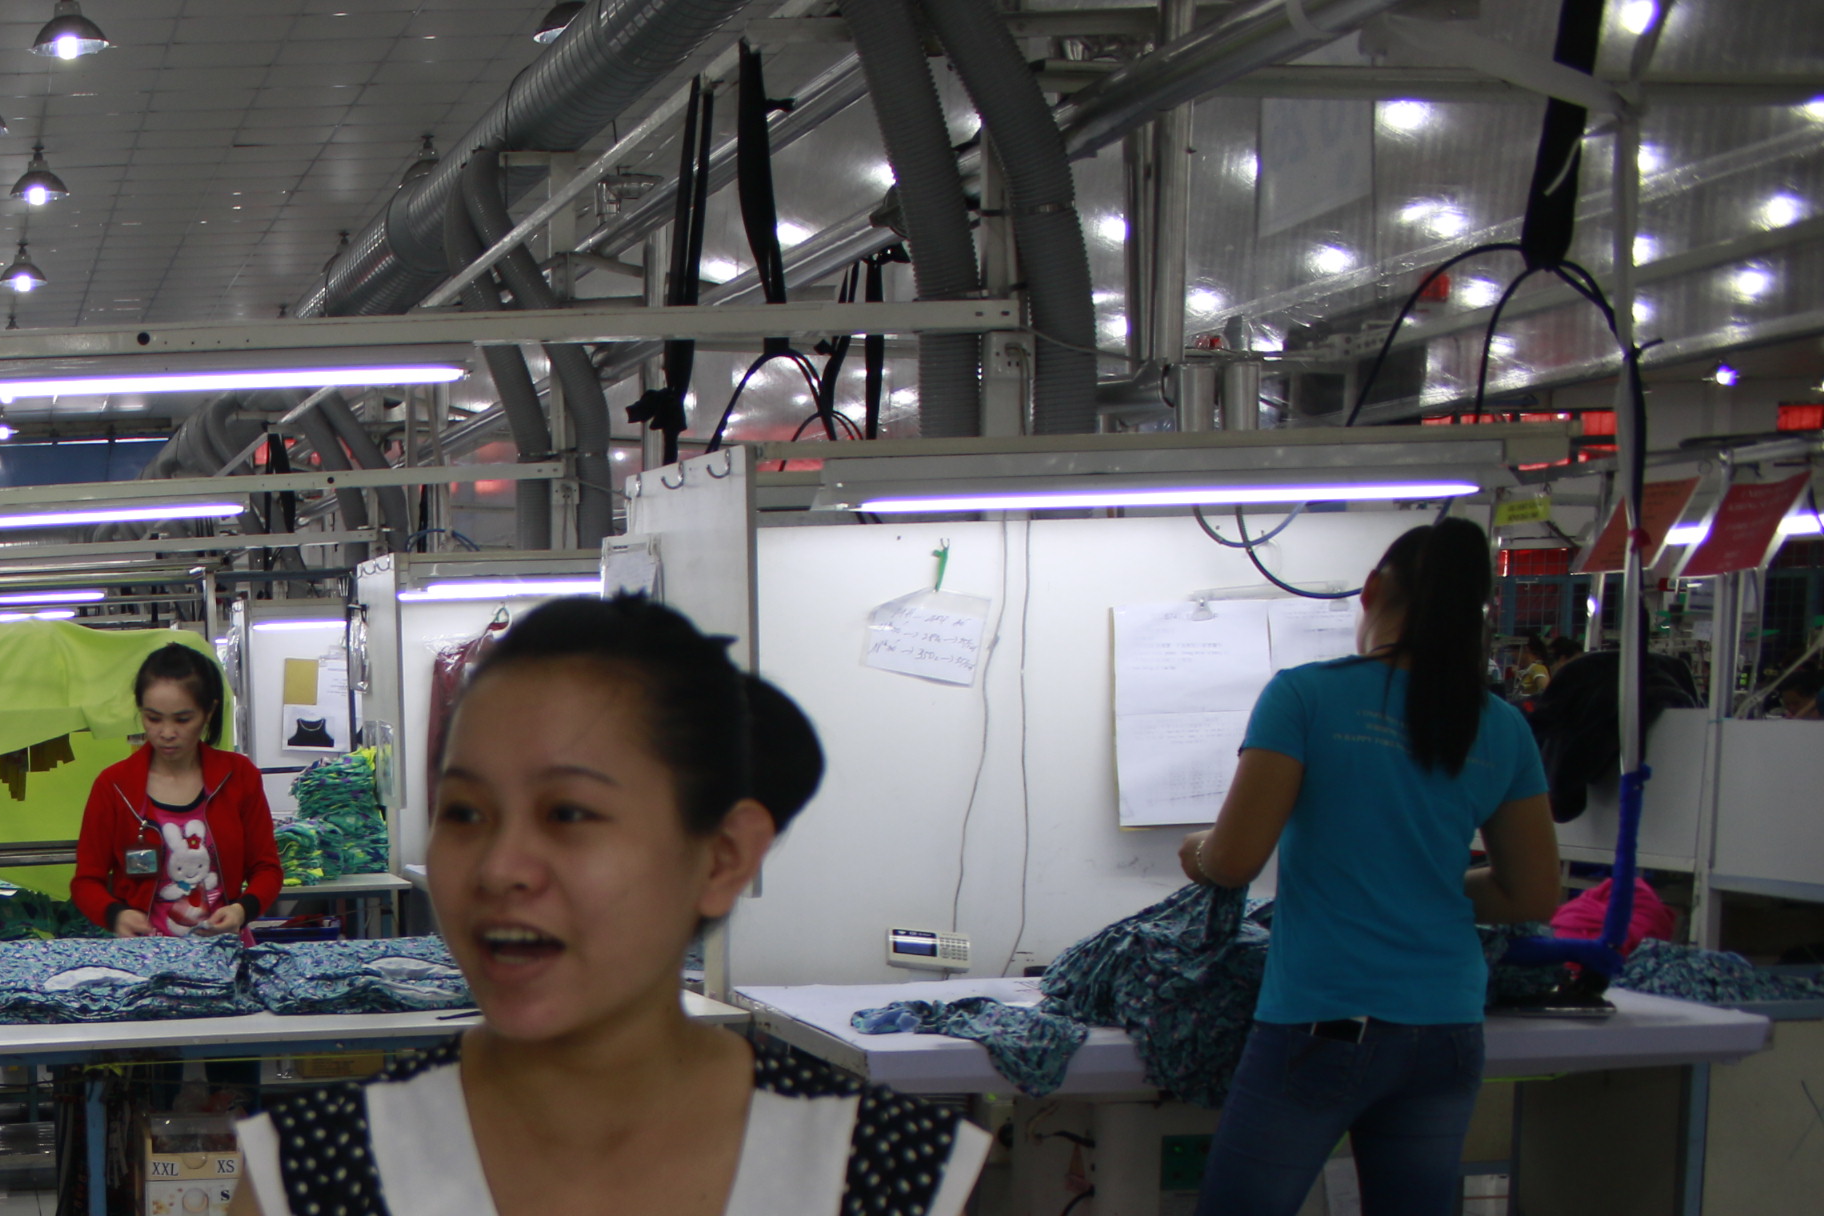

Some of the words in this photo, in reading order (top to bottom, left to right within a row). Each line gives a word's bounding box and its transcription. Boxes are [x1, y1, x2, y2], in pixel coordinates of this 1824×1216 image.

[152, 1161, 179, 1176] XXL
[217, 1159, 235, 1173] XS
[220, 1190, 230, 1201] S
